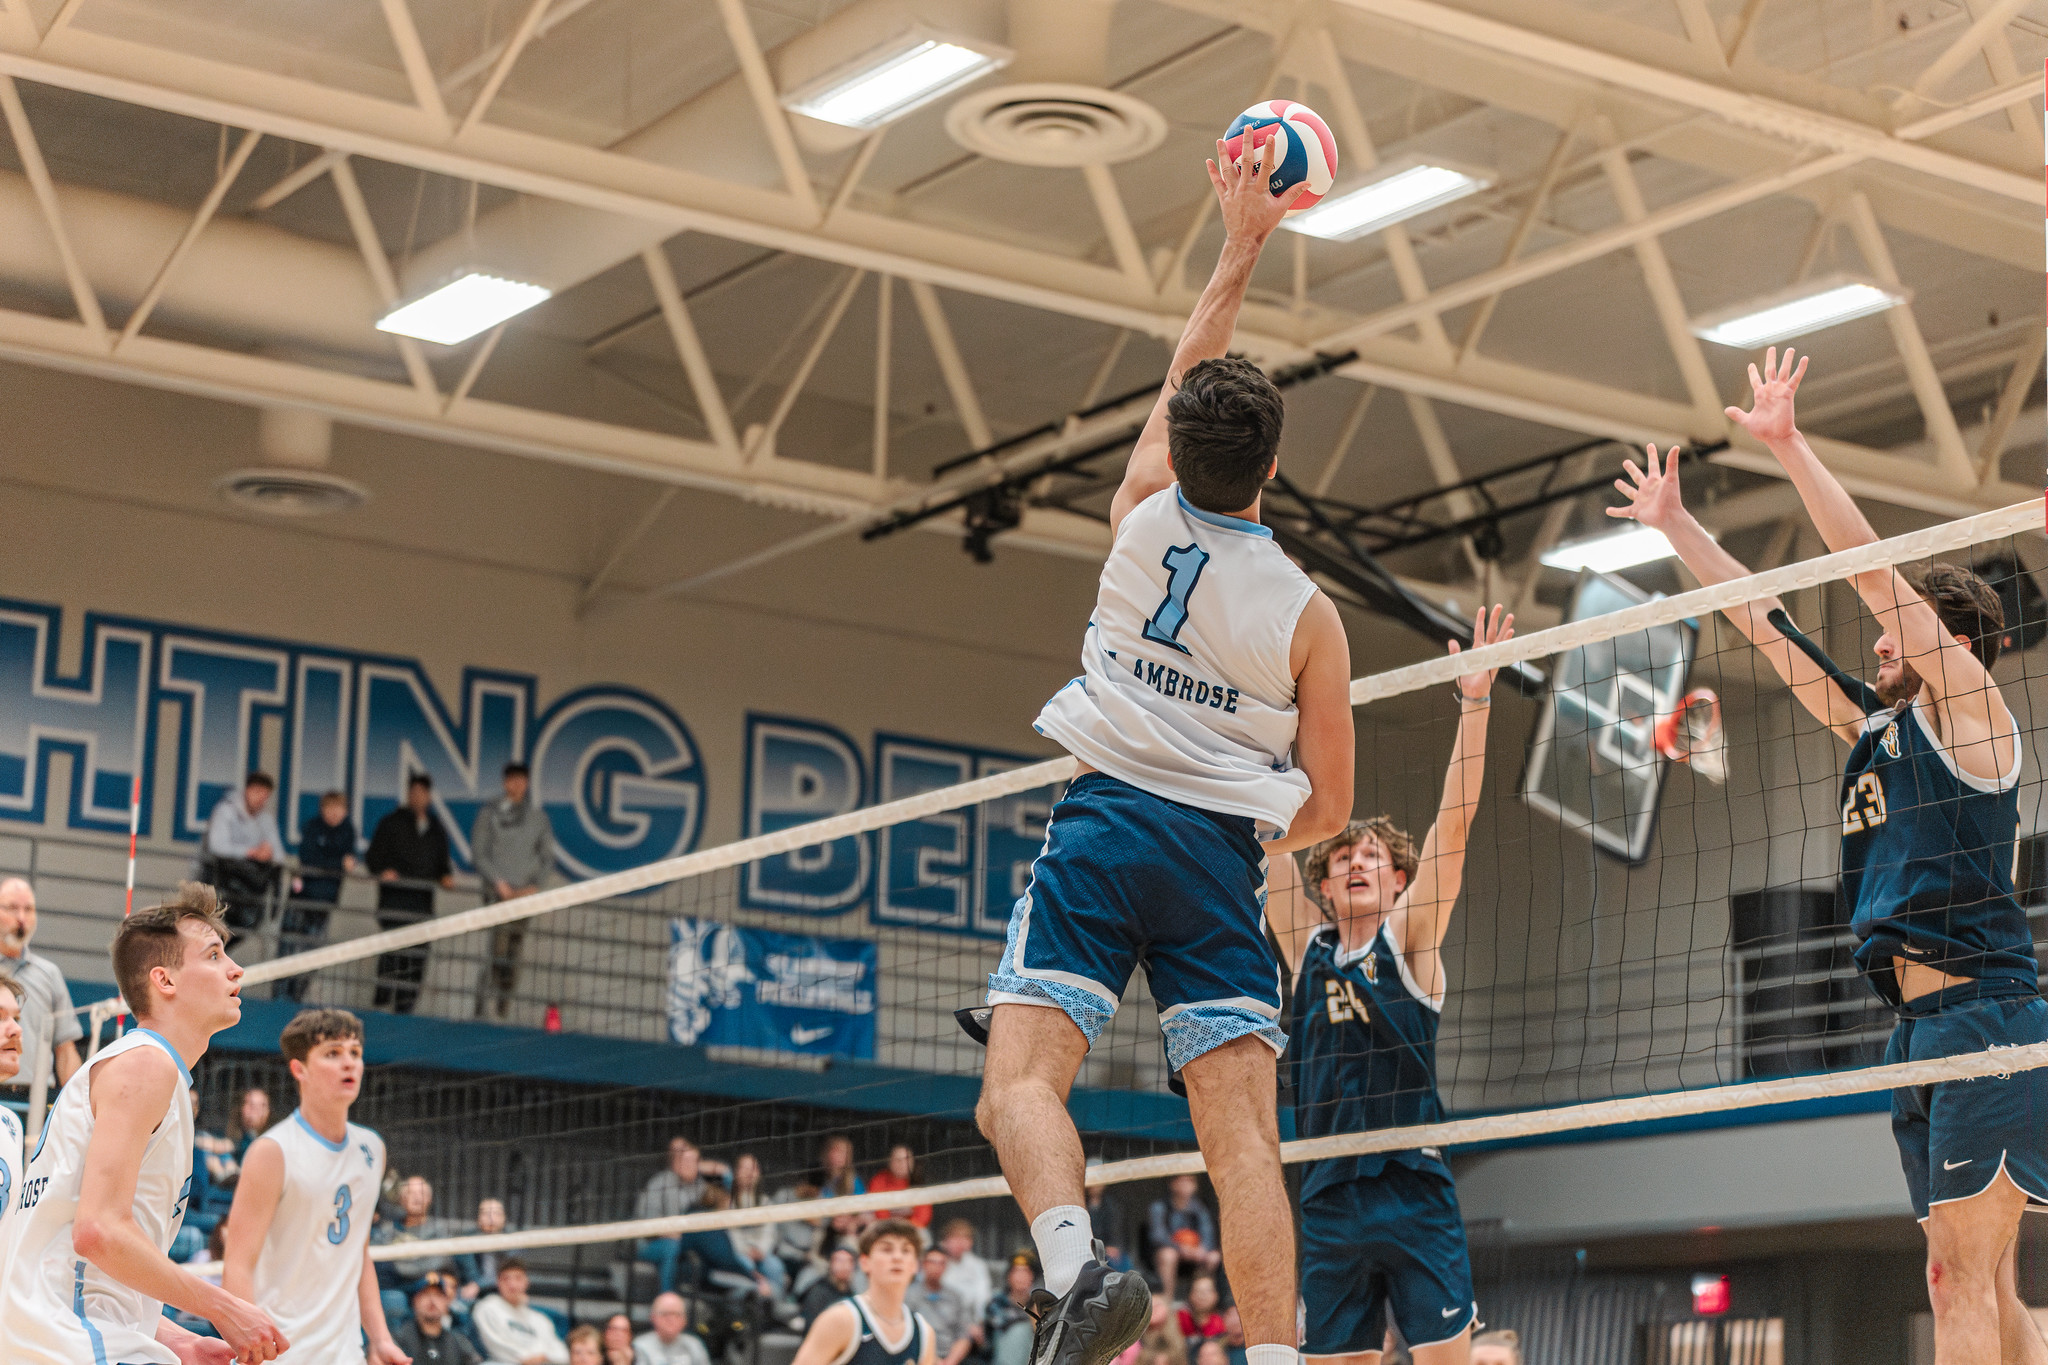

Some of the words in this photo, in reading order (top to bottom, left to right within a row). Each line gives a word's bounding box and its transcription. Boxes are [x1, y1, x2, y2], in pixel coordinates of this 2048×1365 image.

[1141, 542, 1210, 657] 1
[1133, 658, 1240, 714] AMBROSE
[1842, 771, 1888, 837] 23
[327, 1183, 353, 1246] 3
